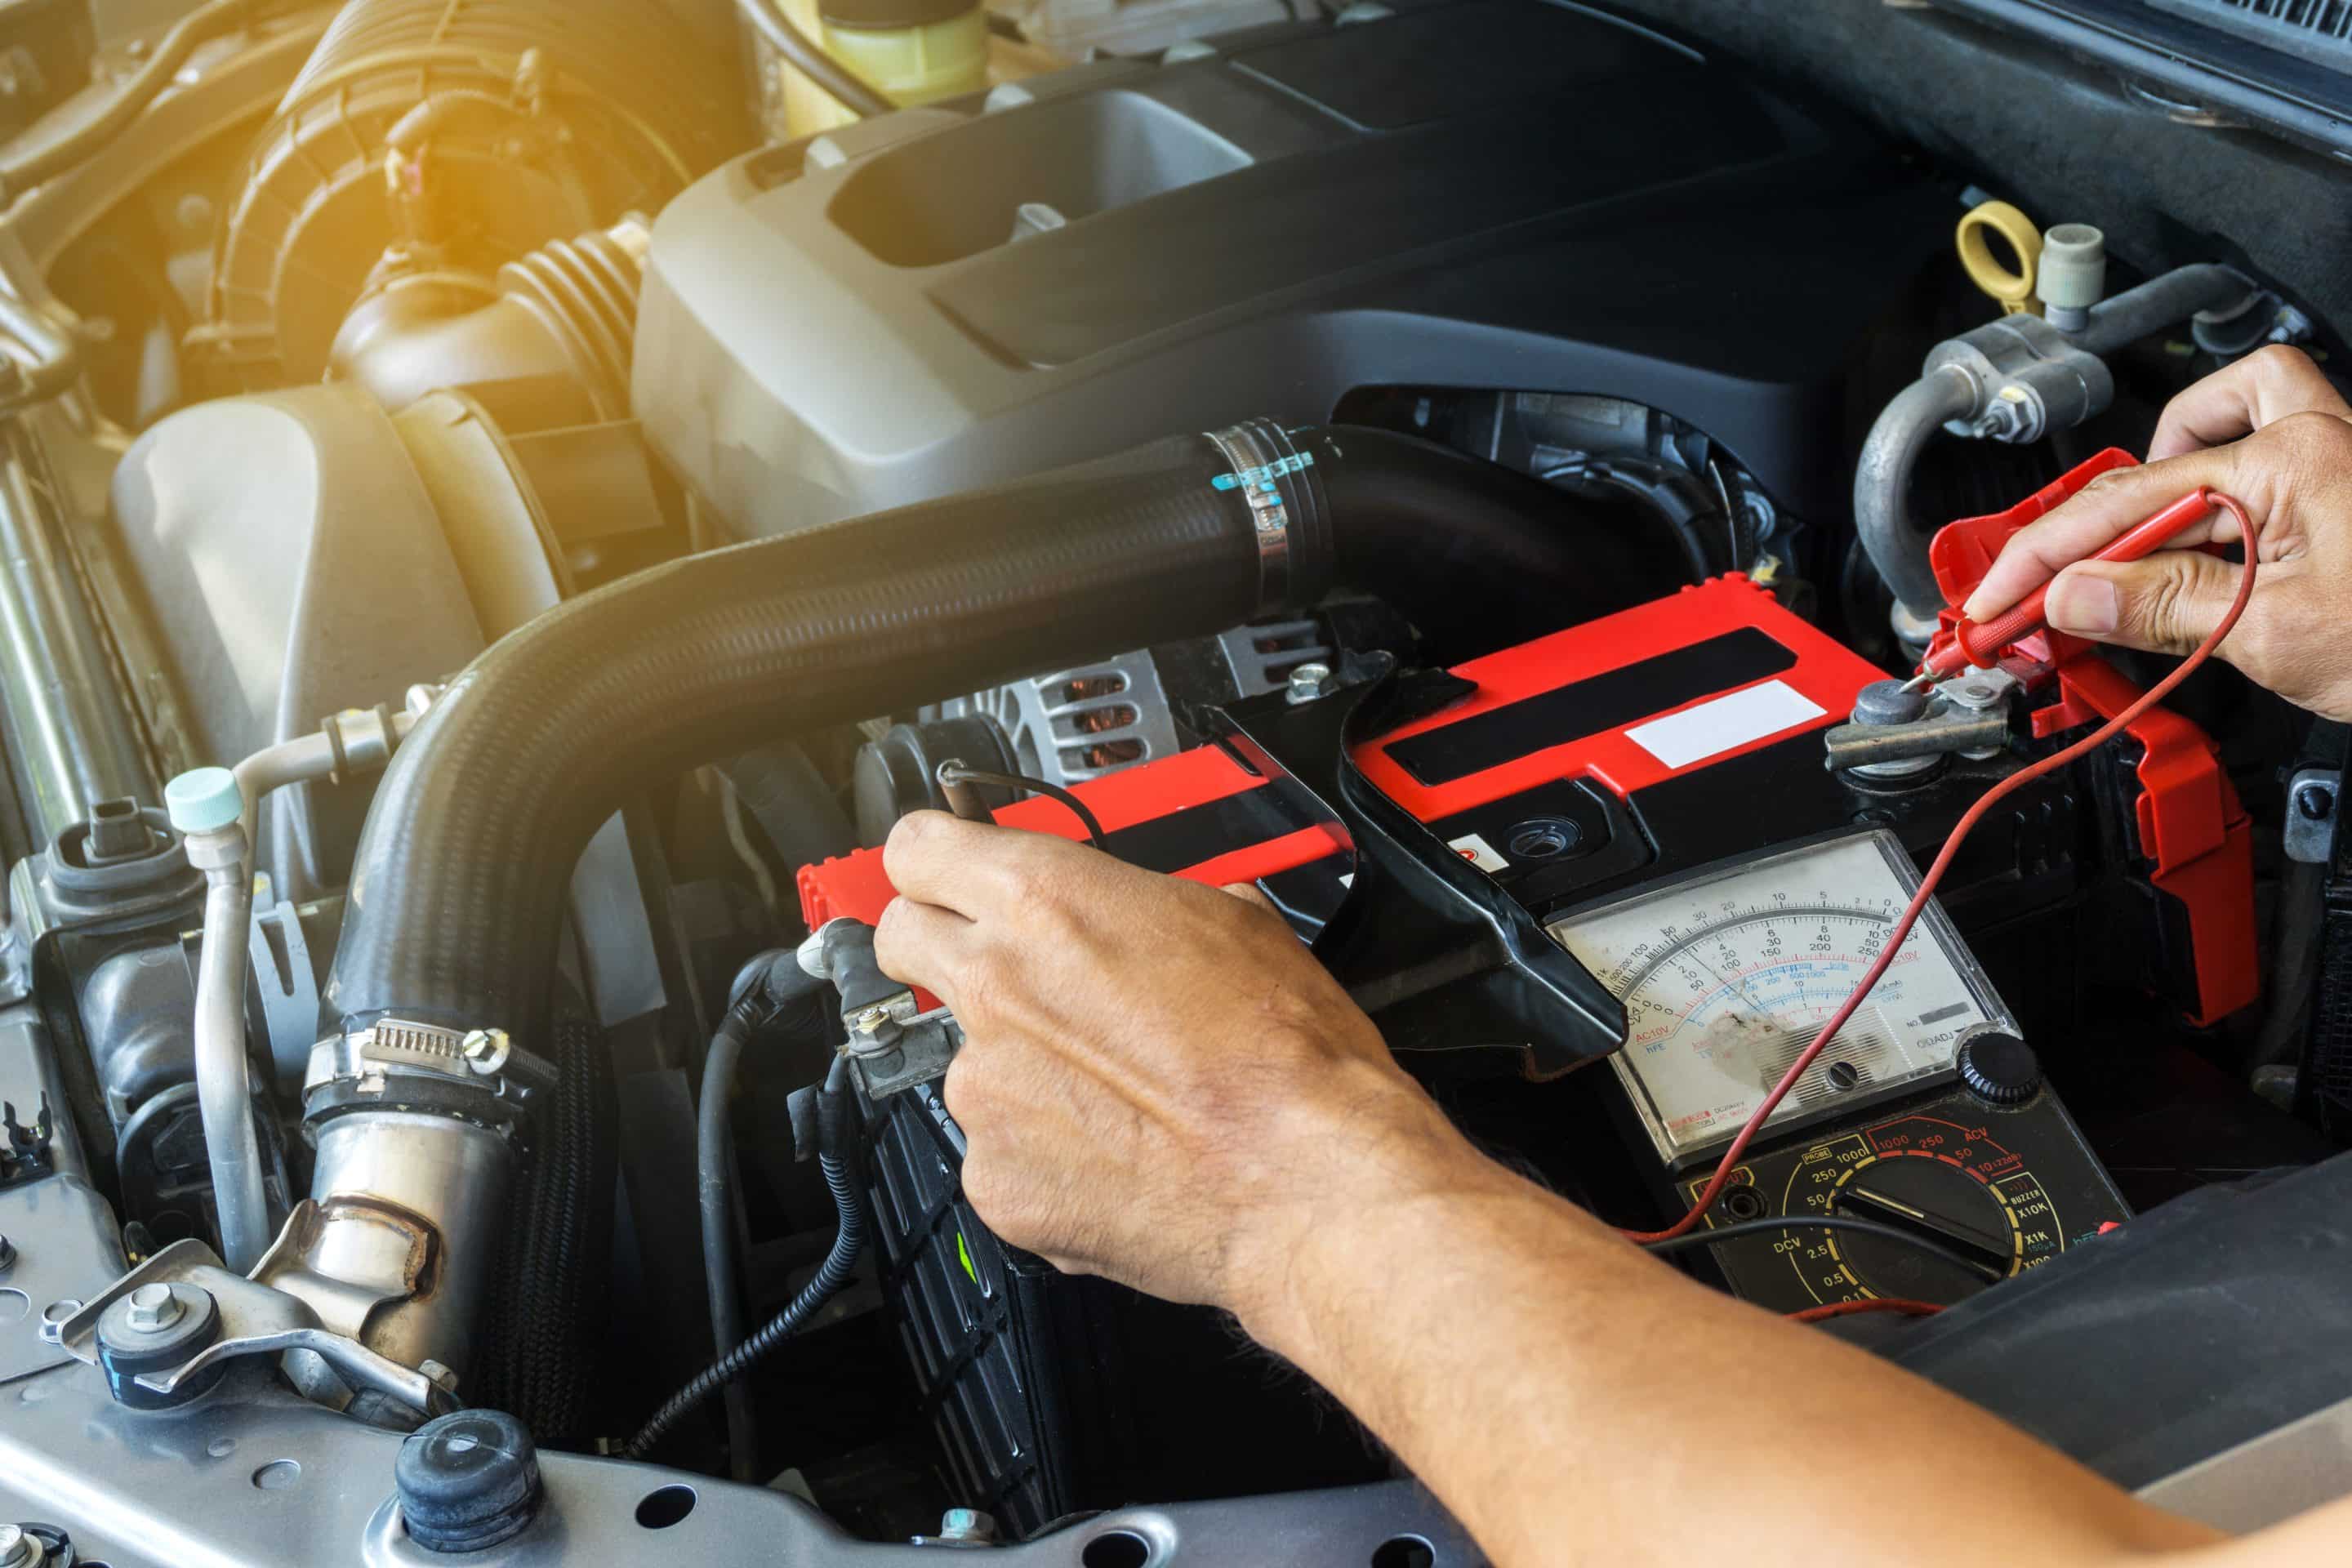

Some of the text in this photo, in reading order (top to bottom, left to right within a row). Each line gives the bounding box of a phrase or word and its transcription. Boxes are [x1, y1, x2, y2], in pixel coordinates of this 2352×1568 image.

[1631, 943, 1648, 958] 100
[1692, 911, 1707, 921] 30
[1720, 901, 1735, 911] 20
[1773, 893, 1785, 901] 10
[1820, 891, 1827, 899] 5
[1883, 898, 1891, 906] 0
[1678, 965, 1686, 973] 2
[1868, 930, 1879, 939] 10
[1684, 970, 1697, 980] 10
[1722, 950, 1736, 960] 20
[1766, 937, 1781, 947] 30
[1864, 938, 1879, 947] 50
[1690, 979, 1704, 991] 50
[1721, 959, 1741, 971] 100
[1761, 947, 1781, 957] 150
[1809, 943, 1831, 951] 200
[1857, 947, 1880, 957] 250
[1636, 1025, 1669, 1043] AC10V
[1964, 1127, 1988, 1142] ACV
[1804, 1148, 1830, 1162] PROBE
[1880, 1134, 1973, 1160] 1000 250 50
[1837, 1148, 1866, 1164] 1000
[1812, 1169, 1837, 1183] 250
[1806, 1193, 1825, 1206] 50
[2010, 1189, 2041, 1205] BUZZER
[2017, 1202, 2049, 1219] X10K
[1773, 1236, 1802, 1254] DCV
[2025, 1231, 2049, 1245] X1K
[1806, 1244, 1829, 1259] 2.5
[1823, 1272, 1844, 1287] 0.5
